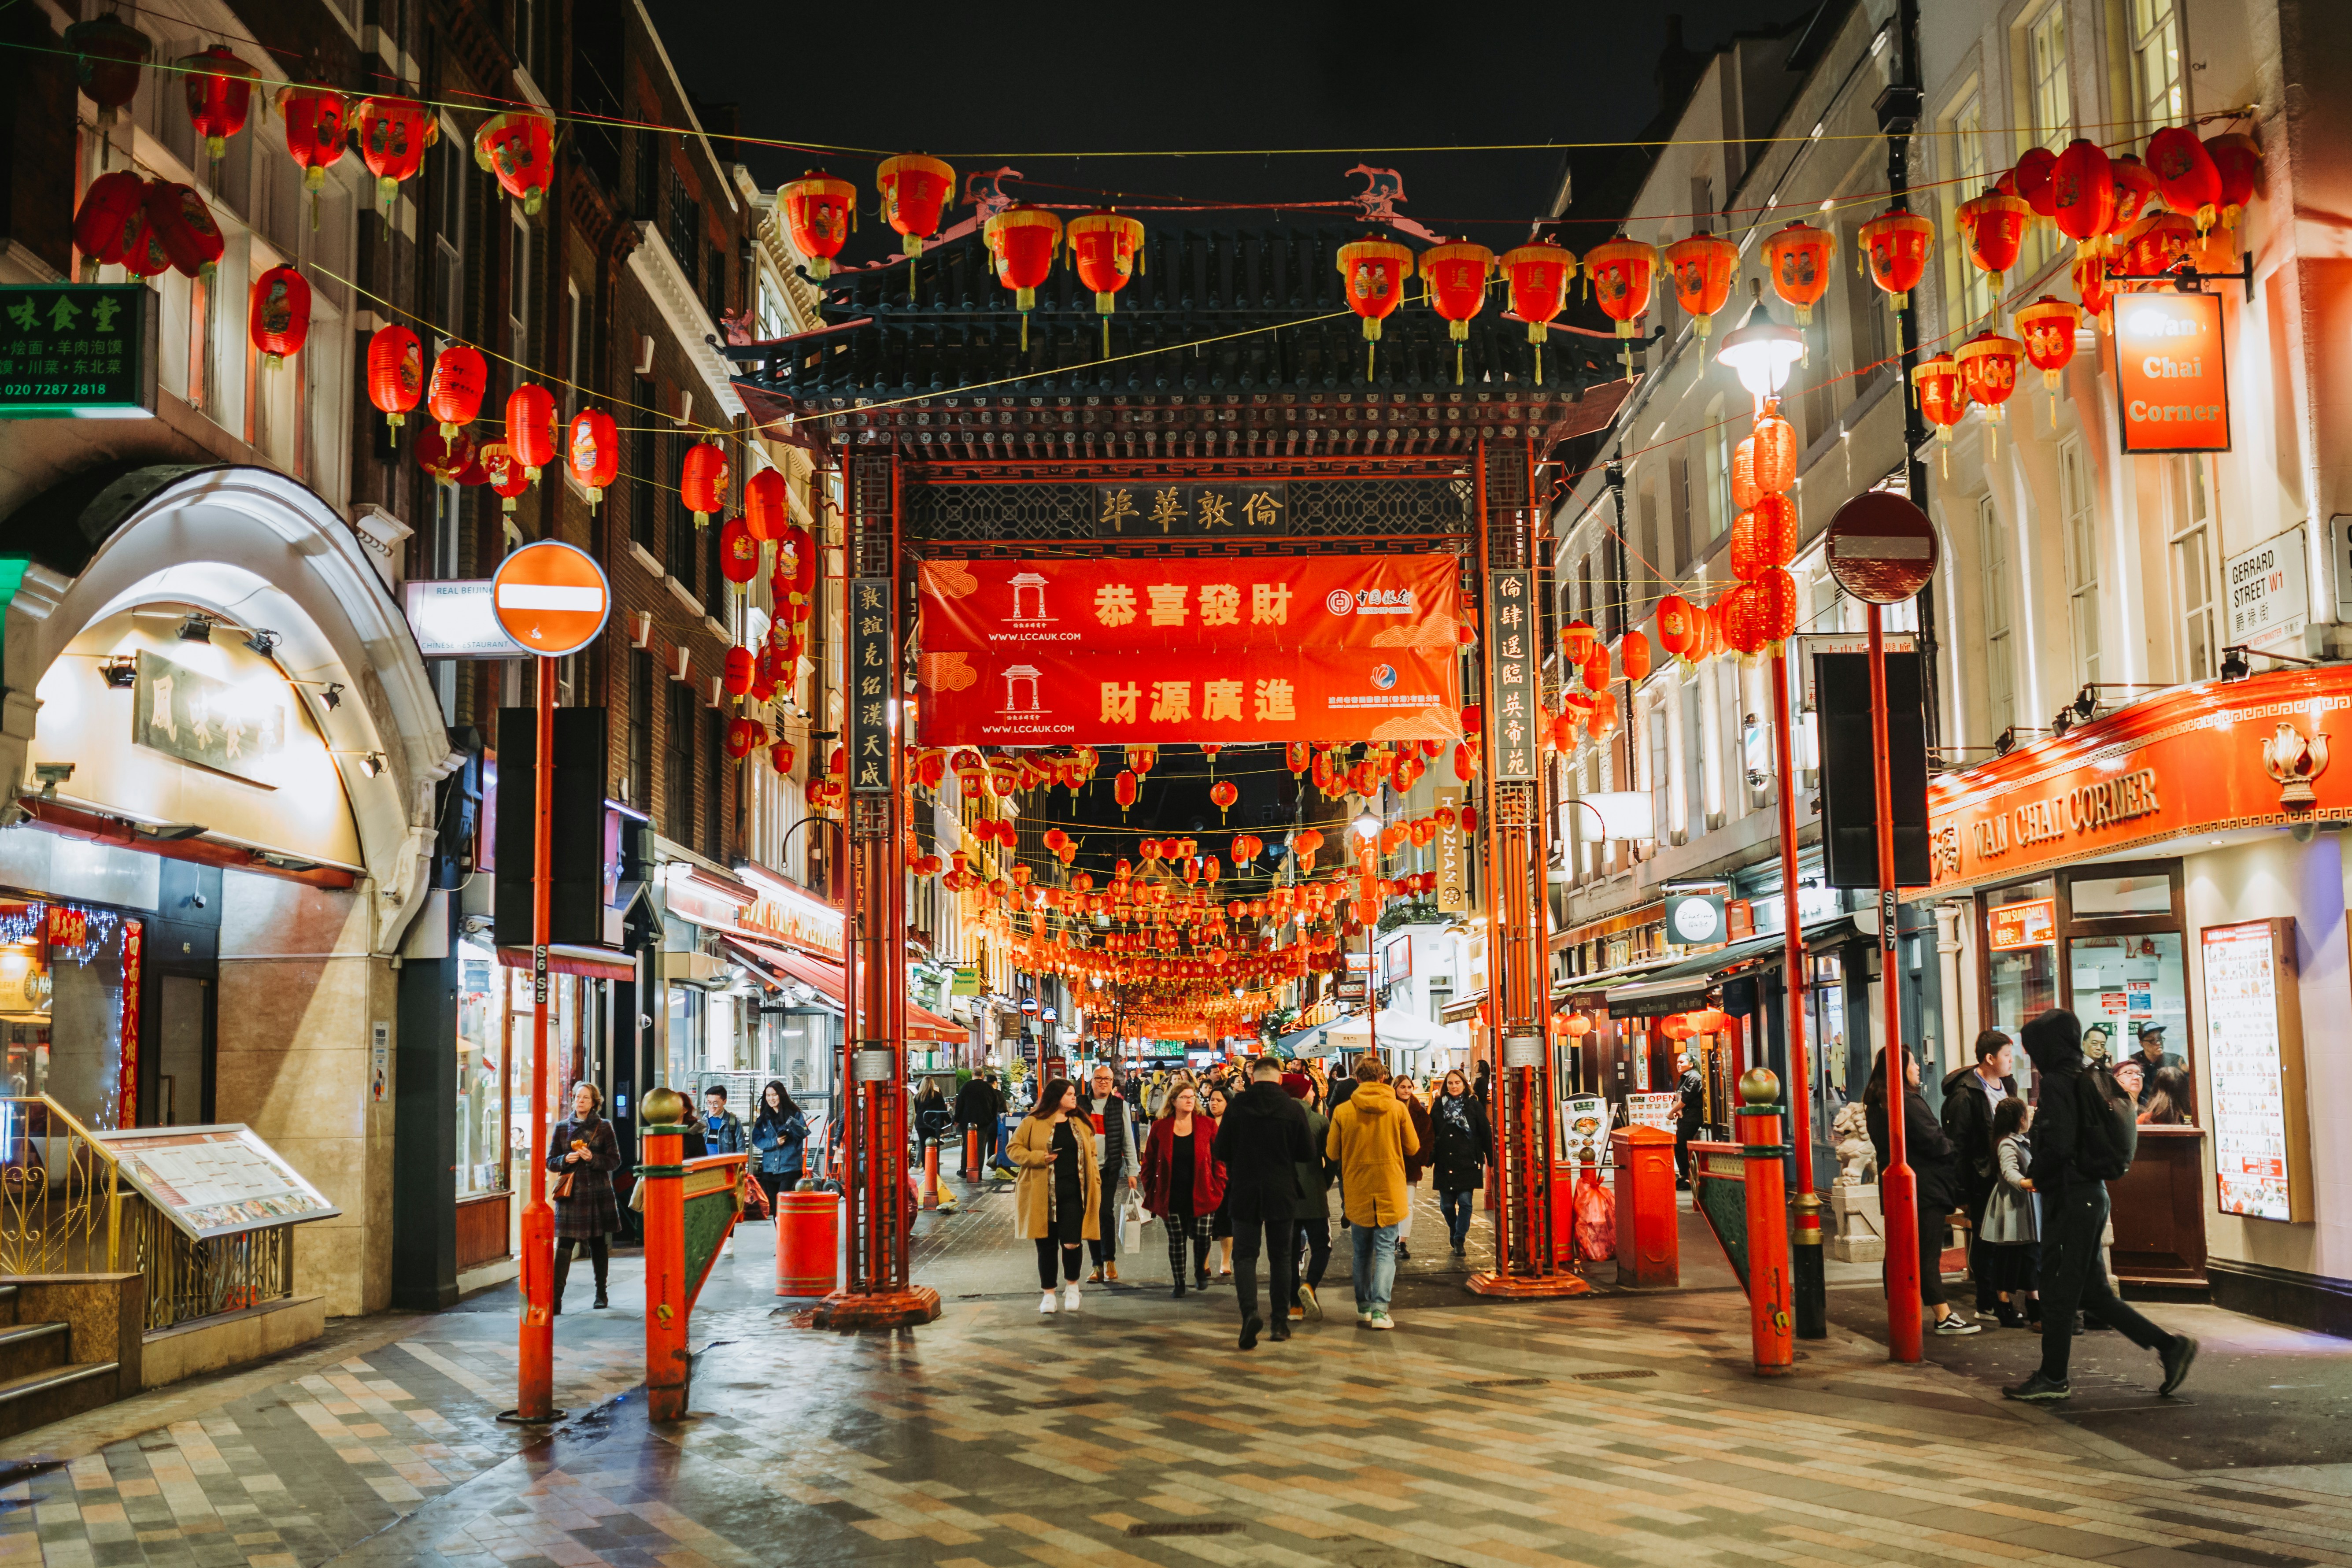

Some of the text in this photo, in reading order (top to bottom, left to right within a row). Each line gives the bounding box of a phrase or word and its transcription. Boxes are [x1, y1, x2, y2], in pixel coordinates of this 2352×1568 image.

[2142, 356, 2203, 378] Chai
[5, 384, 106, 395] 020 7287 2818
[2129, 399, 2220, 422] Corner
[2233, 550, 2274, 585] GERRARD
[1094, 582, 1293, 628] 恭喜發財
[2234, 570, 2283, 608] STREET W1
[2253, 628, 2282, 646] WESTMINSTER
[1099, 677, 1296, 725] 財源廣進
[1971, 768, 2160, 860] WAN CHAI CORNER
[1442, 796, 1457, 882] HOZHAN
[1884, 891, 1895, 949] S8 S7
[1998, 905, 2045, 925] DIM SUM DAILY
[536, 945, 547, 1003] S6 S5
